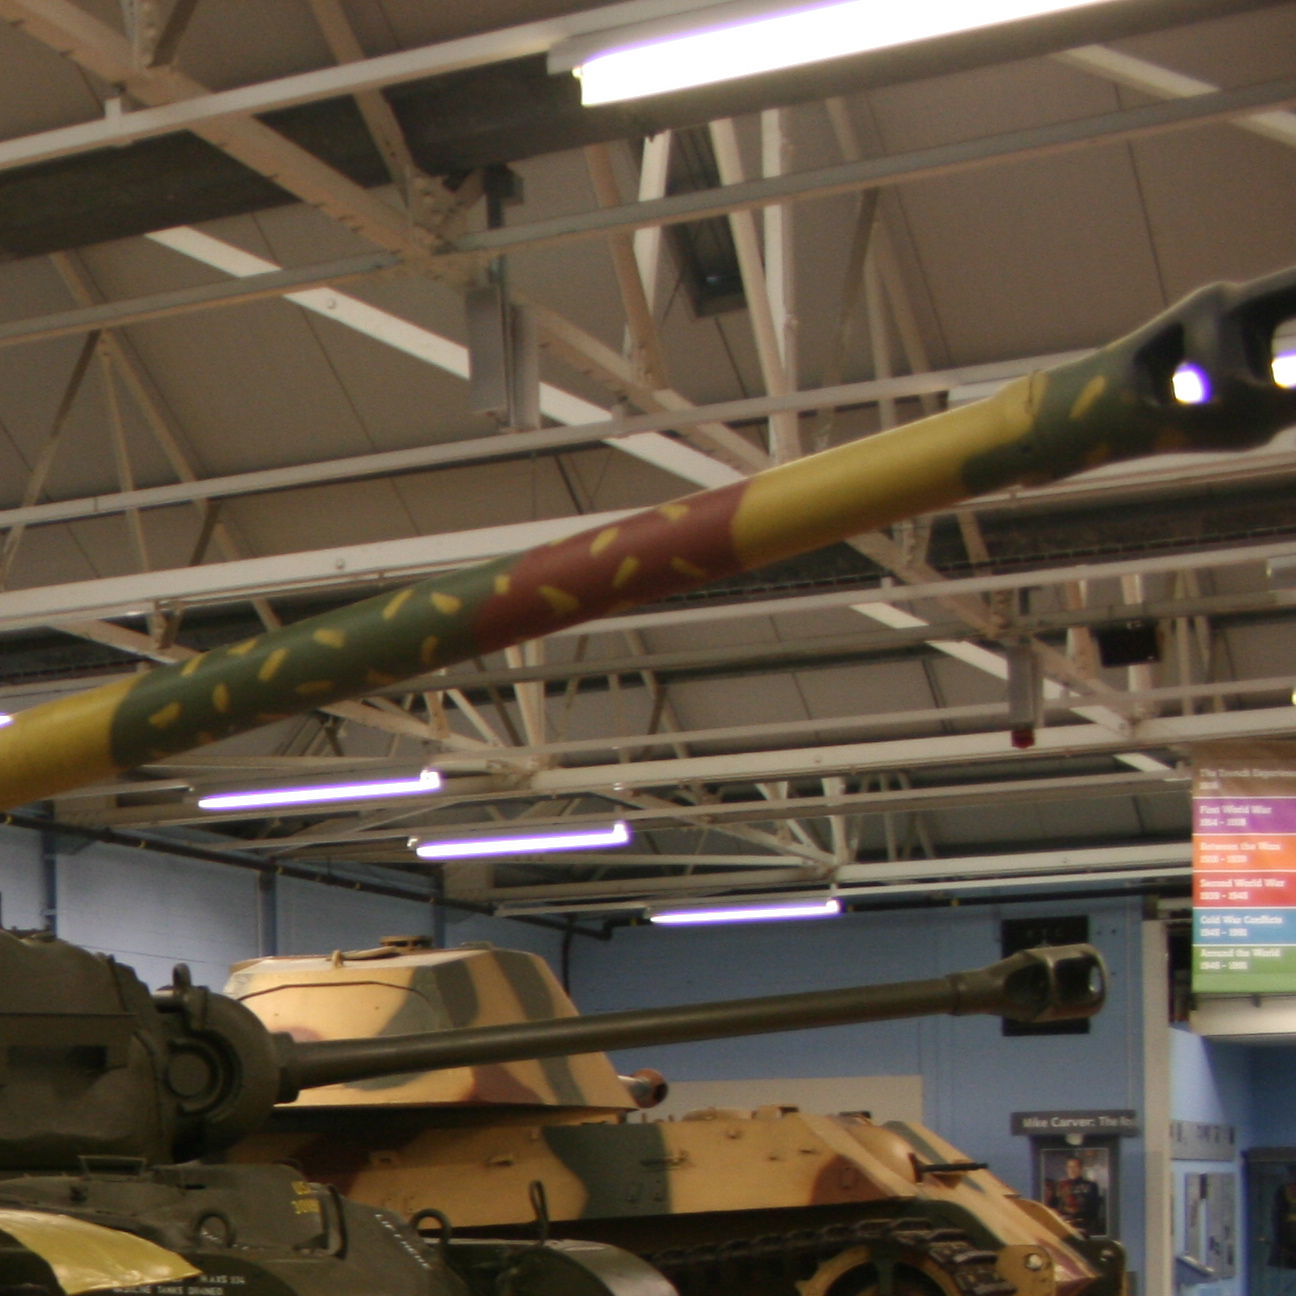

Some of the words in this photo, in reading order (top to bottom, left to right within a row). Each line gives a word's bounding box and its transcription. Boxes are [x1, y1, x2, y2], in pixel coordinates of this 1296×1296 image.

[1199, 805, 1220, 814] First
[1221, 805, 1250, 814] World
[1250, 805, 1272, 814] War
[1199, 818, 1218, 827] 1914
[1200, 842, 1239, 851] Between
[1240, 842, 1256, 851] the
[1258, 842, 1281, 851] Wars
[1199, 879, 1233, 888] Second
[1233, 879, 1263, 888] World
[1263, 879, 1285, 888] War
[1199, 891, 1220, 900] 1939
[1228, 891, 1249, 900] 1945
[1199, 915, 1221, 924] Cold
[1222, 915, 1242, 924] War
[1243, 915, 1283, 924] Conflicts
[1199, 948, 1234, 957] Around
[1235, 948, 1250, 957] the
[1251, 948, 1282, 957] World
[1023, 1116, 1048, 1128] Mike
[1098, 1115, 1118, 1127] The
[156, 1285, 184, 1295] TANKS
